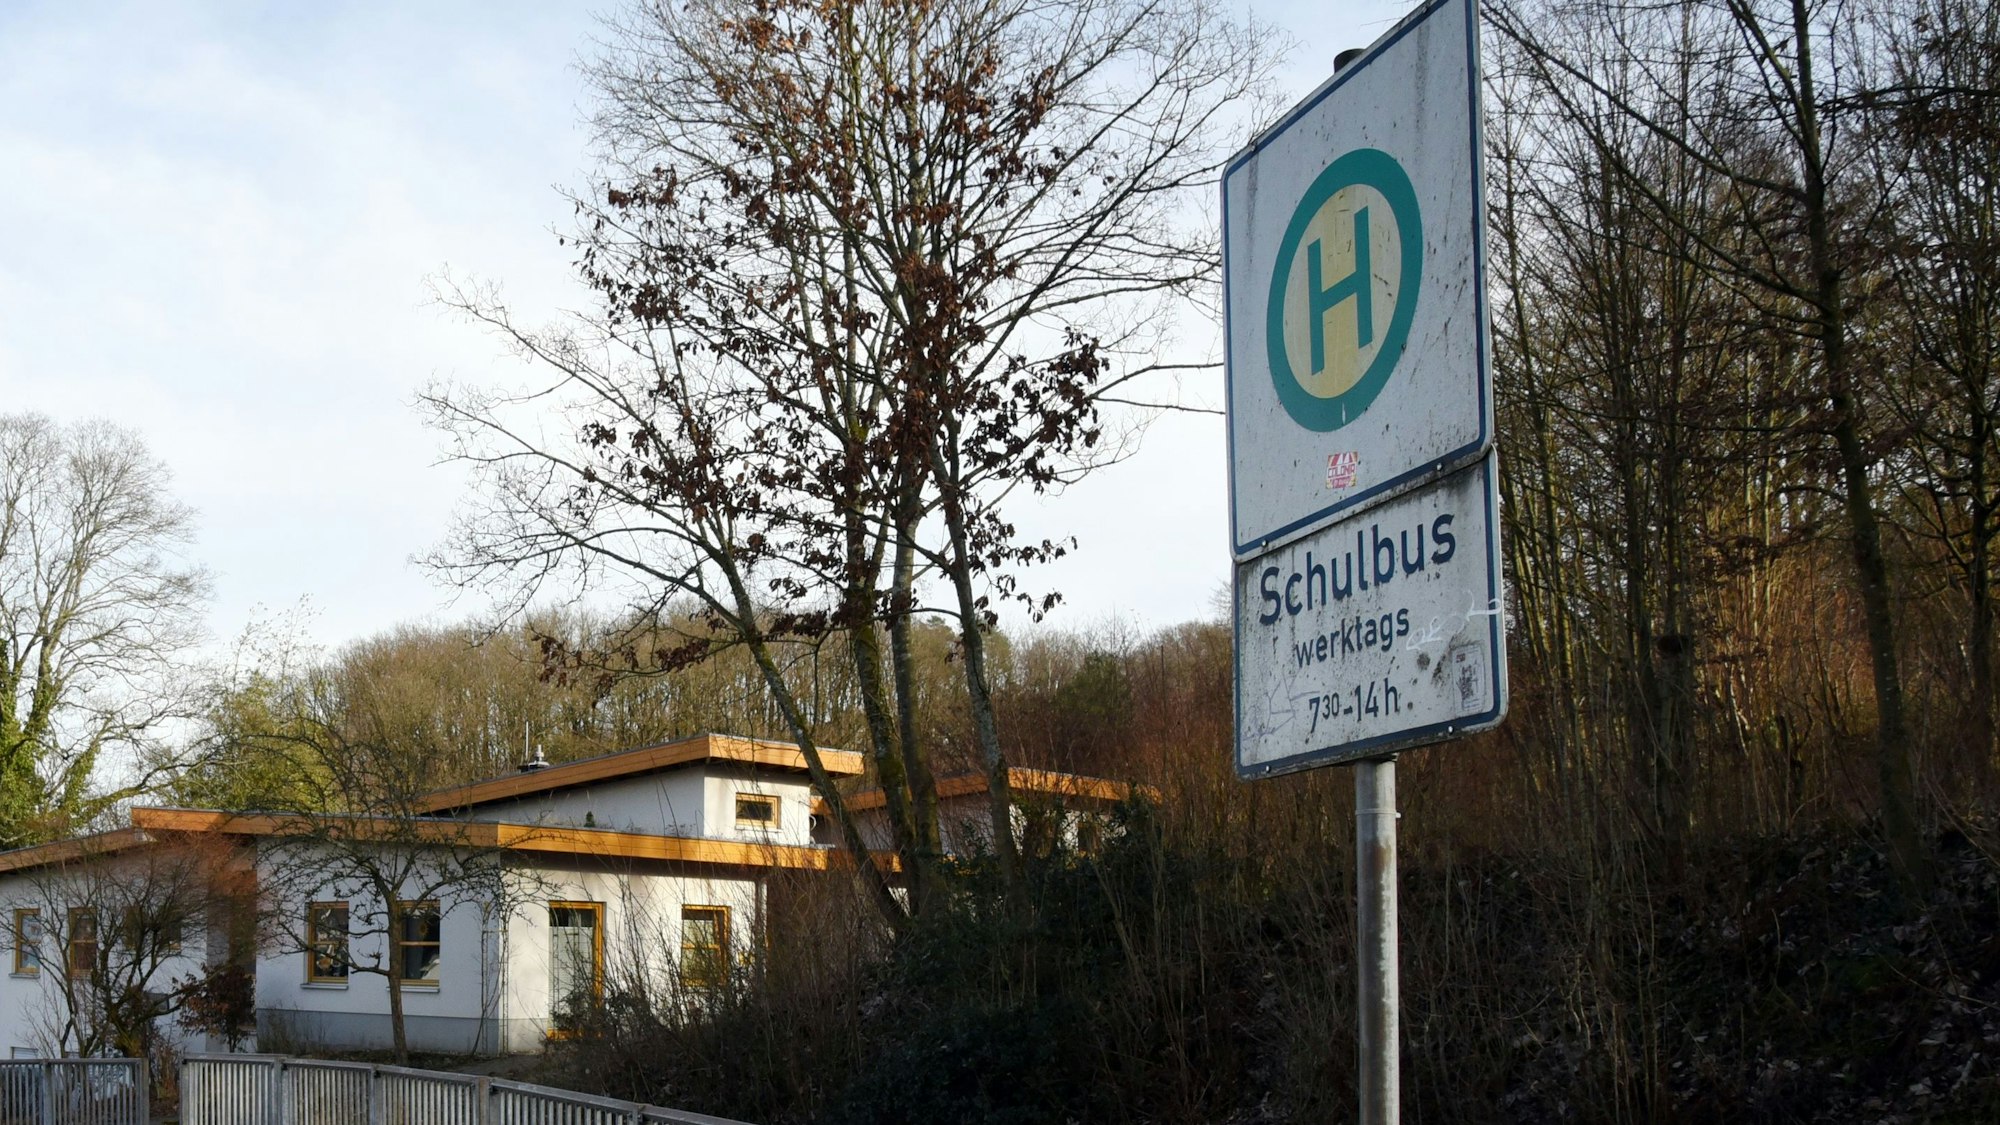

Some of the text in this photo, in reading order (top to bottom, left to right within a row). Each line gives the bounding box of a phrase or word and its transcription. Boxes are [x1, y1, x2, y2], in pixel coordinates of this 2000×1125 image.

[1307, 205, 1373, 376] H
[1259, 513, 1456, 627] Schulbus
[1295, 607, 1410, 668] werktags
